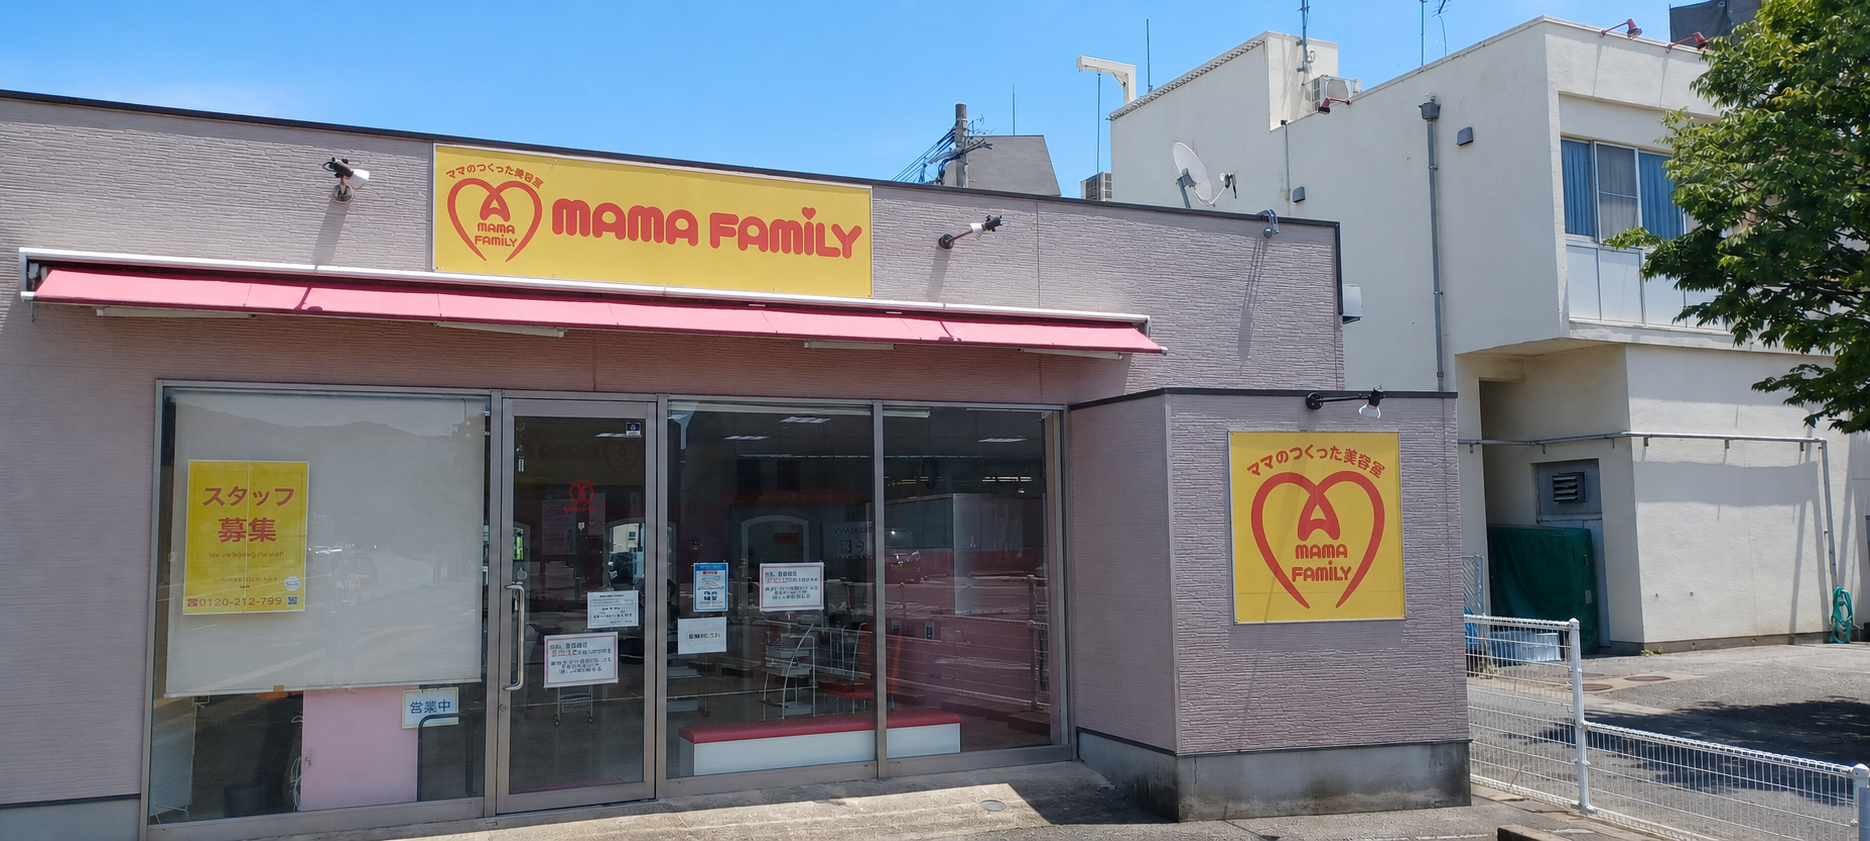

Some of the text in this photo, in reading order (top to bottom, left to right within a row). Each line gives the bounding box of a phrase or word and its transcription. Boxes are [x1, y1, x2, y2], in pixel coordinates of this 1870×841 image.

[477, 222, 515, 234] MAMA
[552, 198, 699, 247] MAMA
[1246, 444, 1386, 479] ママのつくった美容室
[202, 485, 295, 507] スタッフ
[217, 517, 277, 543] 募集
[1295, 543, 1348, 560] MAMA
[199, 596, 282, 607] 0120-212-799
[409, 699, 451, 714] 営業中
